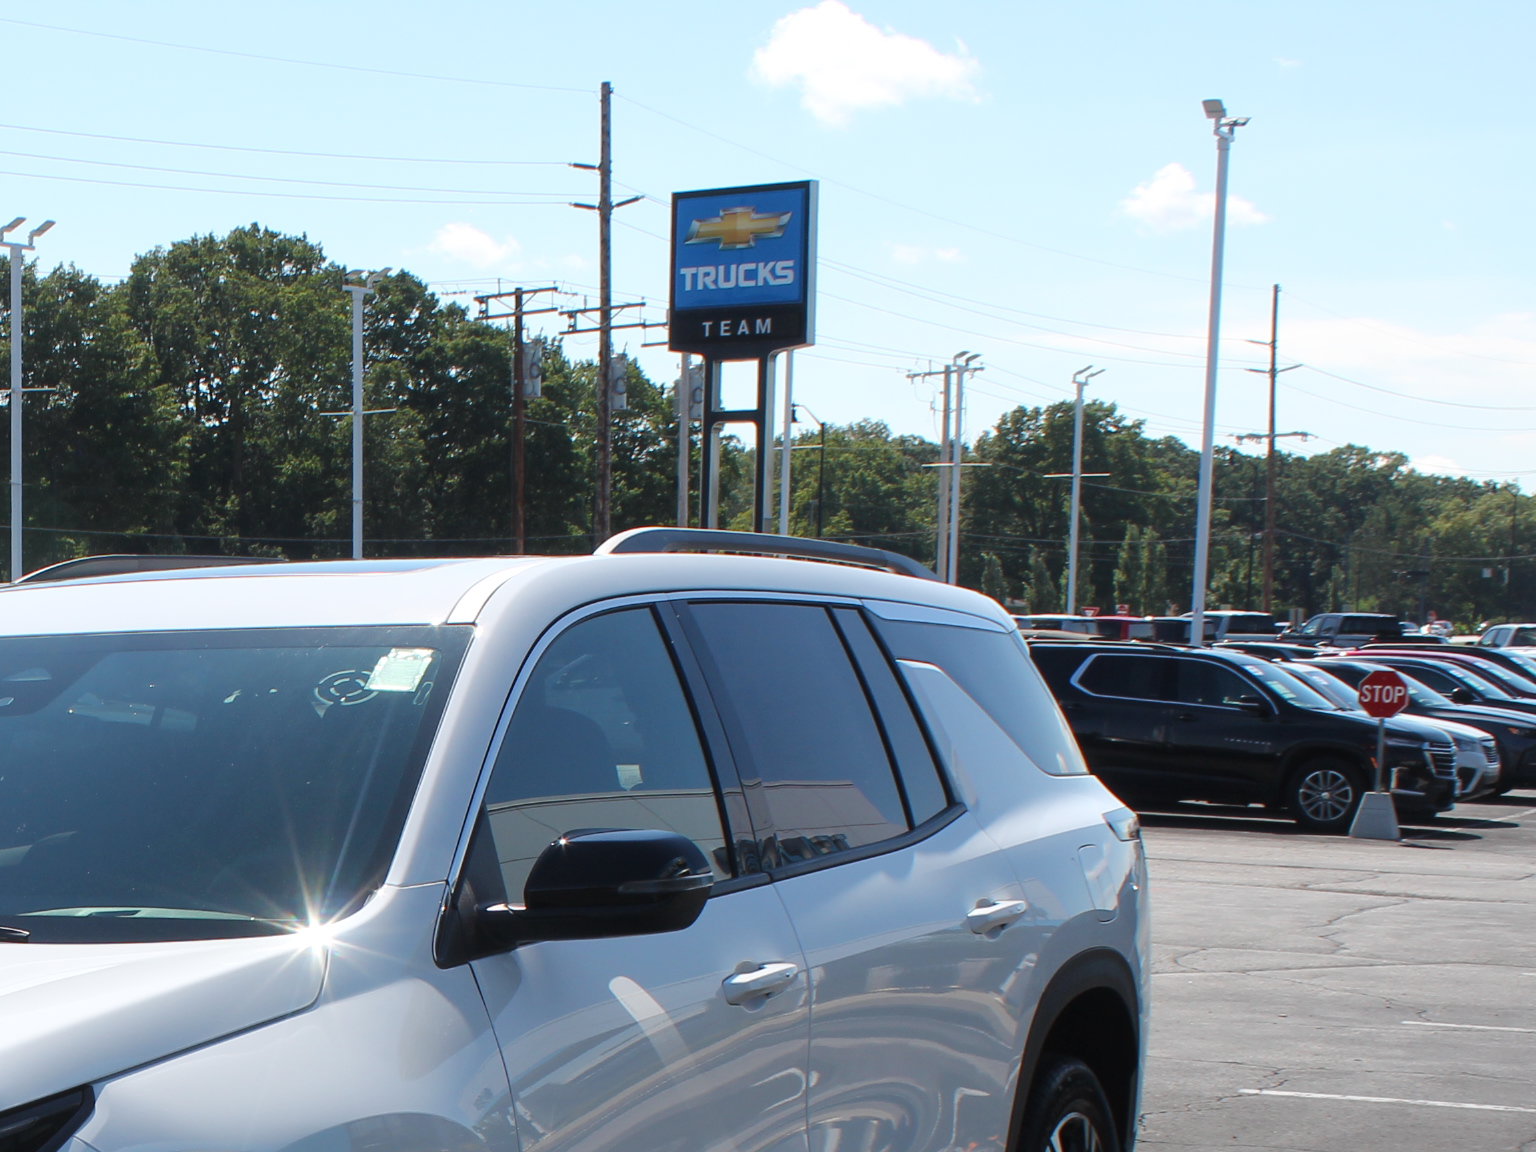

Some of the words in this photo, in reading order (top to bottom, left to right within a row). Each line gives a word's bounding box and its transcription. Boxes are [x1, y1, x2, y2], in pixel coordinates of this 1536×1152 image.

[680, 260, 795, 291] TRUCKS
[702, 318, 772, 337] TEAM
[1360, 685, 1405, 703] STOP
